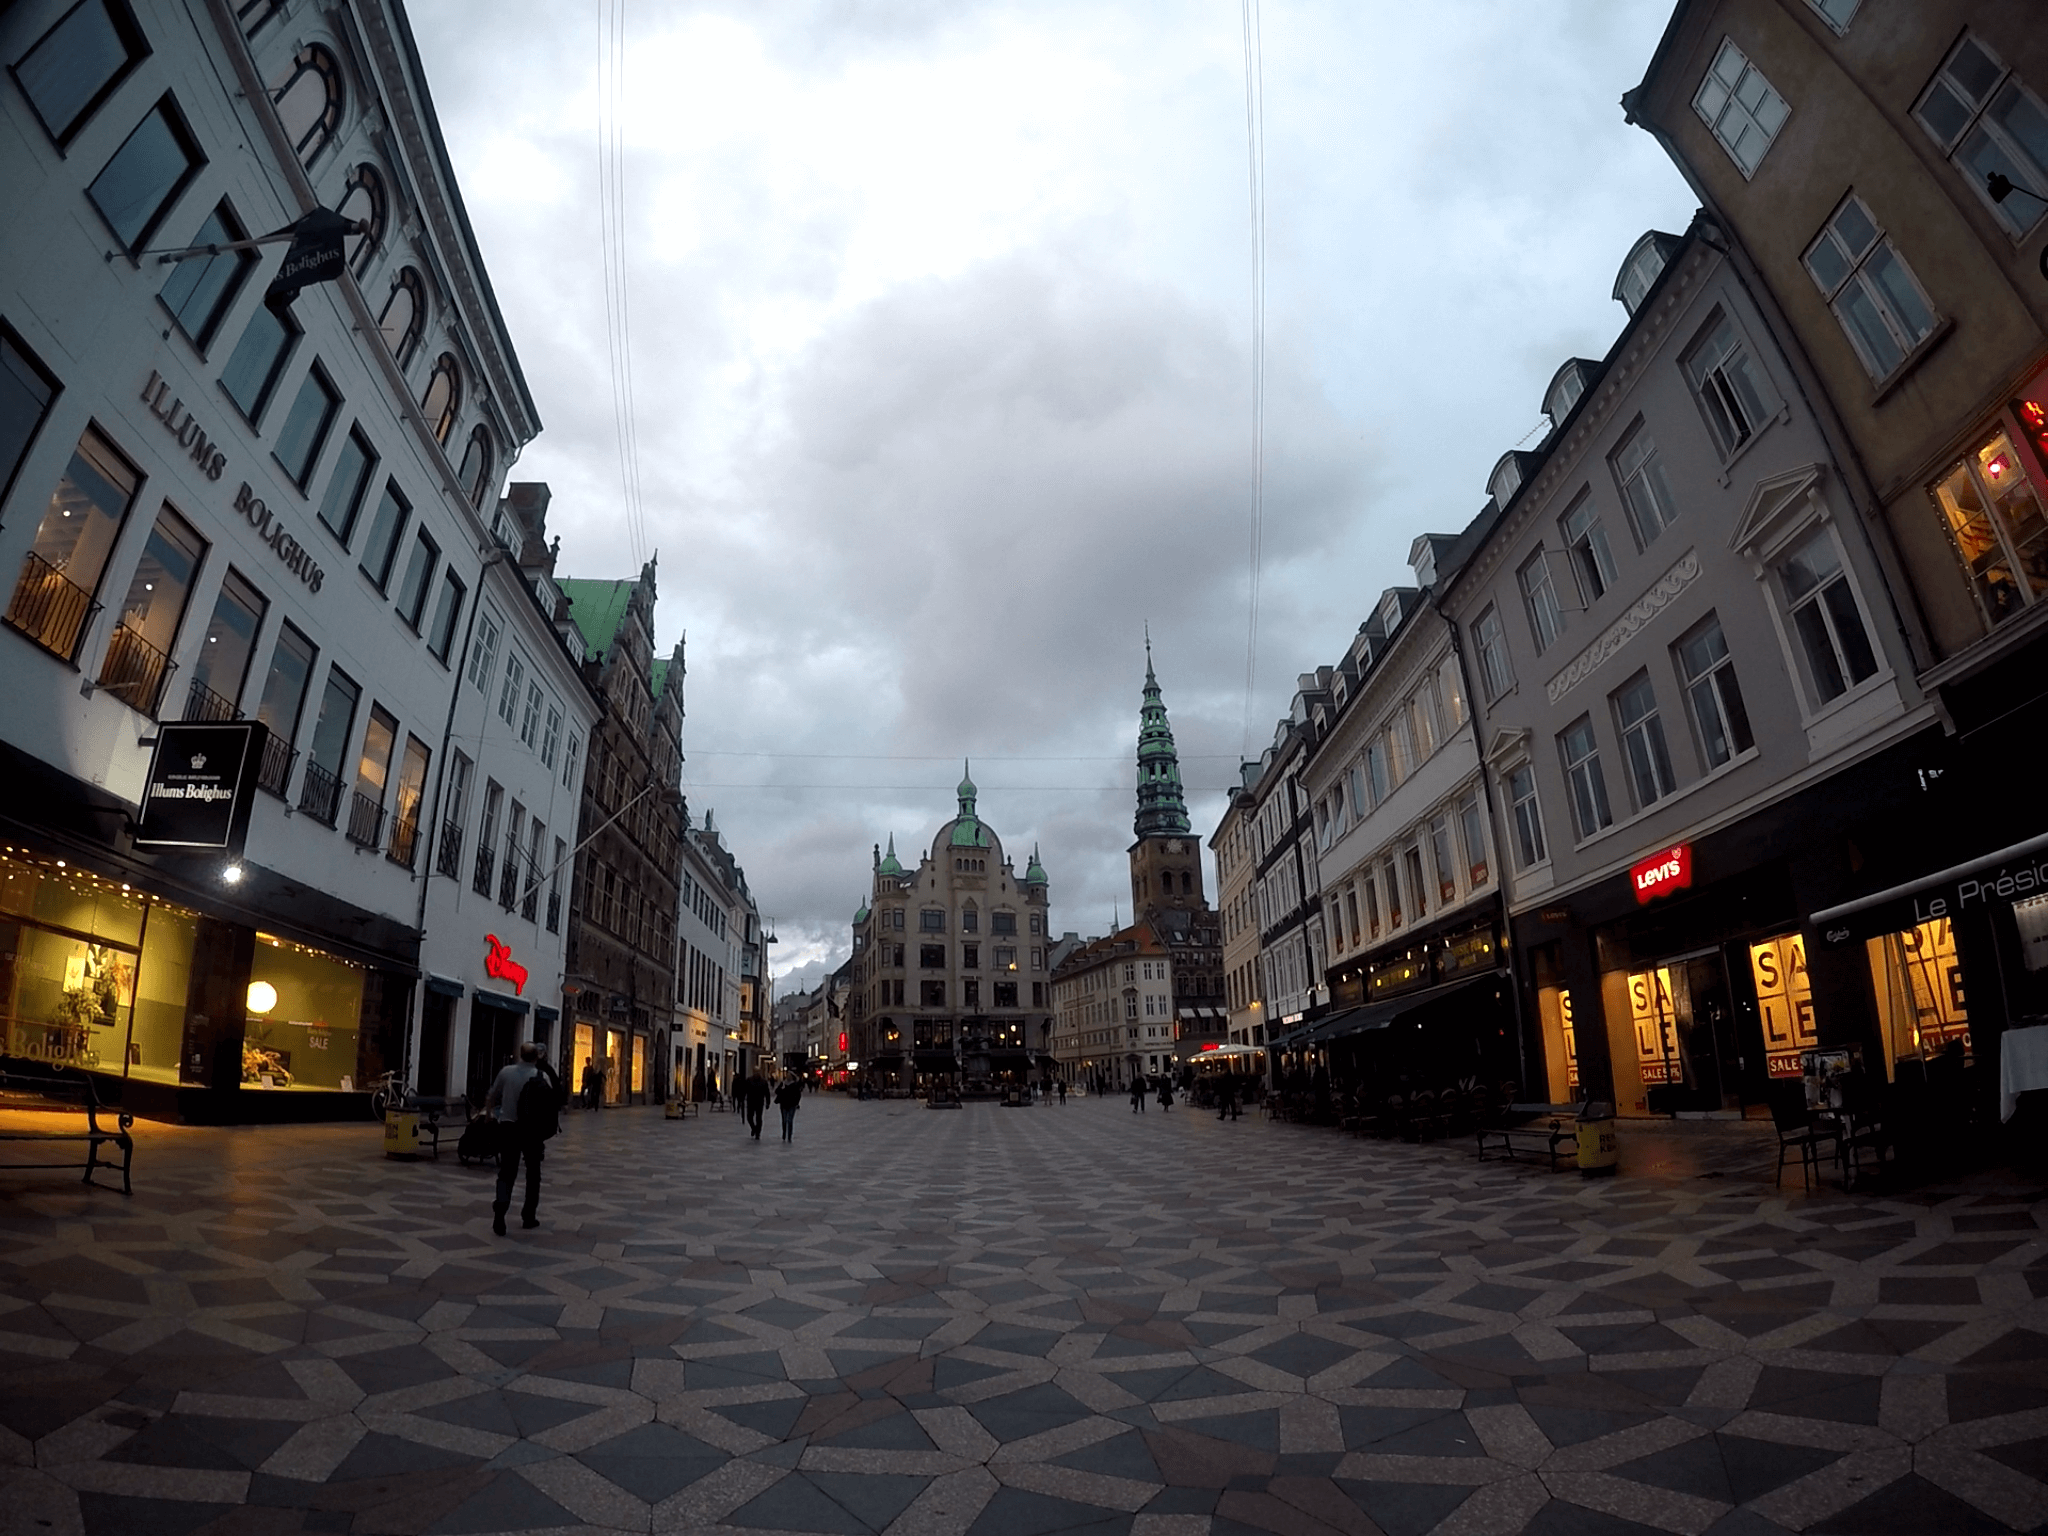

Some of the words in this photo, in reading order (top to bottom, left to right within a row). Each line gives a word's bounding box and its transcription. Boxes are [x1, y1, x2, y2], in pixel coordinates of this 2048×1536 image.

[286, 248, 340, 277] Bolighus
[140, 369, 228, 482] ILLUMS
[233, 480, 325, 594] BOLIGHUS
[150, 782, 185, 799] Illums
[185, 784, 233, 803] Bolighus
[1914, 897, 1947, 922] Le
[309, 1036, 329, 1050] SALE
[1642, 1069, 1663, 1079] SALE
[1769, 1057, 1800, 1073] SALE
